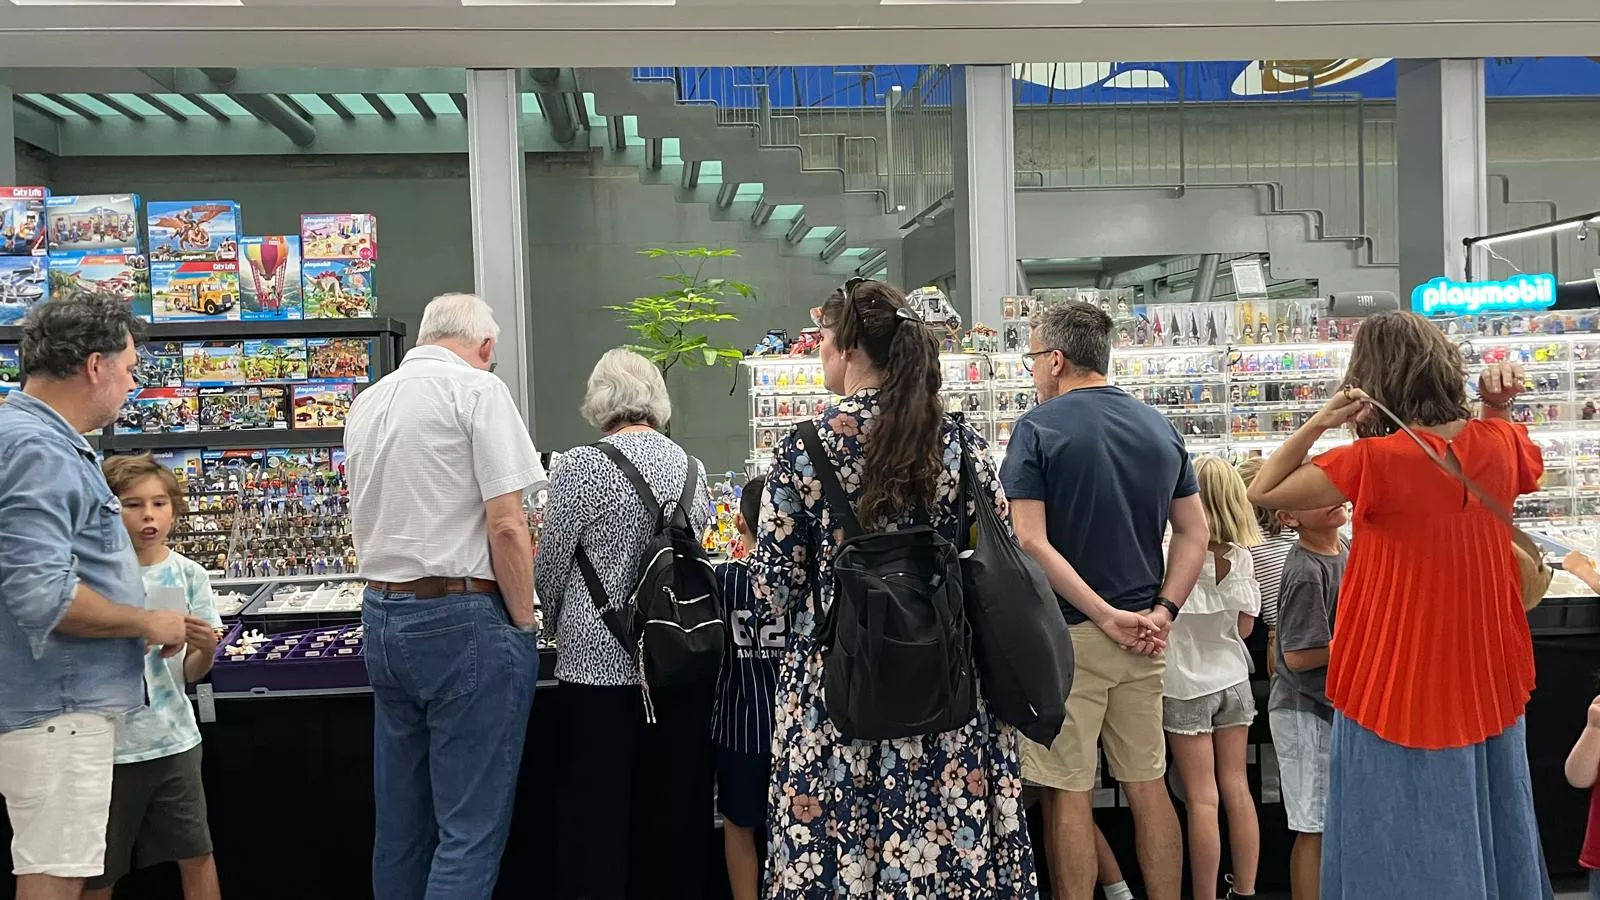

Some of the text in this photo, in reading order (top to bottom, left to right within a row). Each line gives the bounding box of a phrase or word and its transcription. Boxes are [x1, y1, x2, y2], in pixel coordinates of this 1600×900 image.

[13, 188, 42, 197] City Life
[304, 216, 334, 225] playmobil
[213, 263, 225, 271] City
[1422, 277, 1552, 312] playmobil
